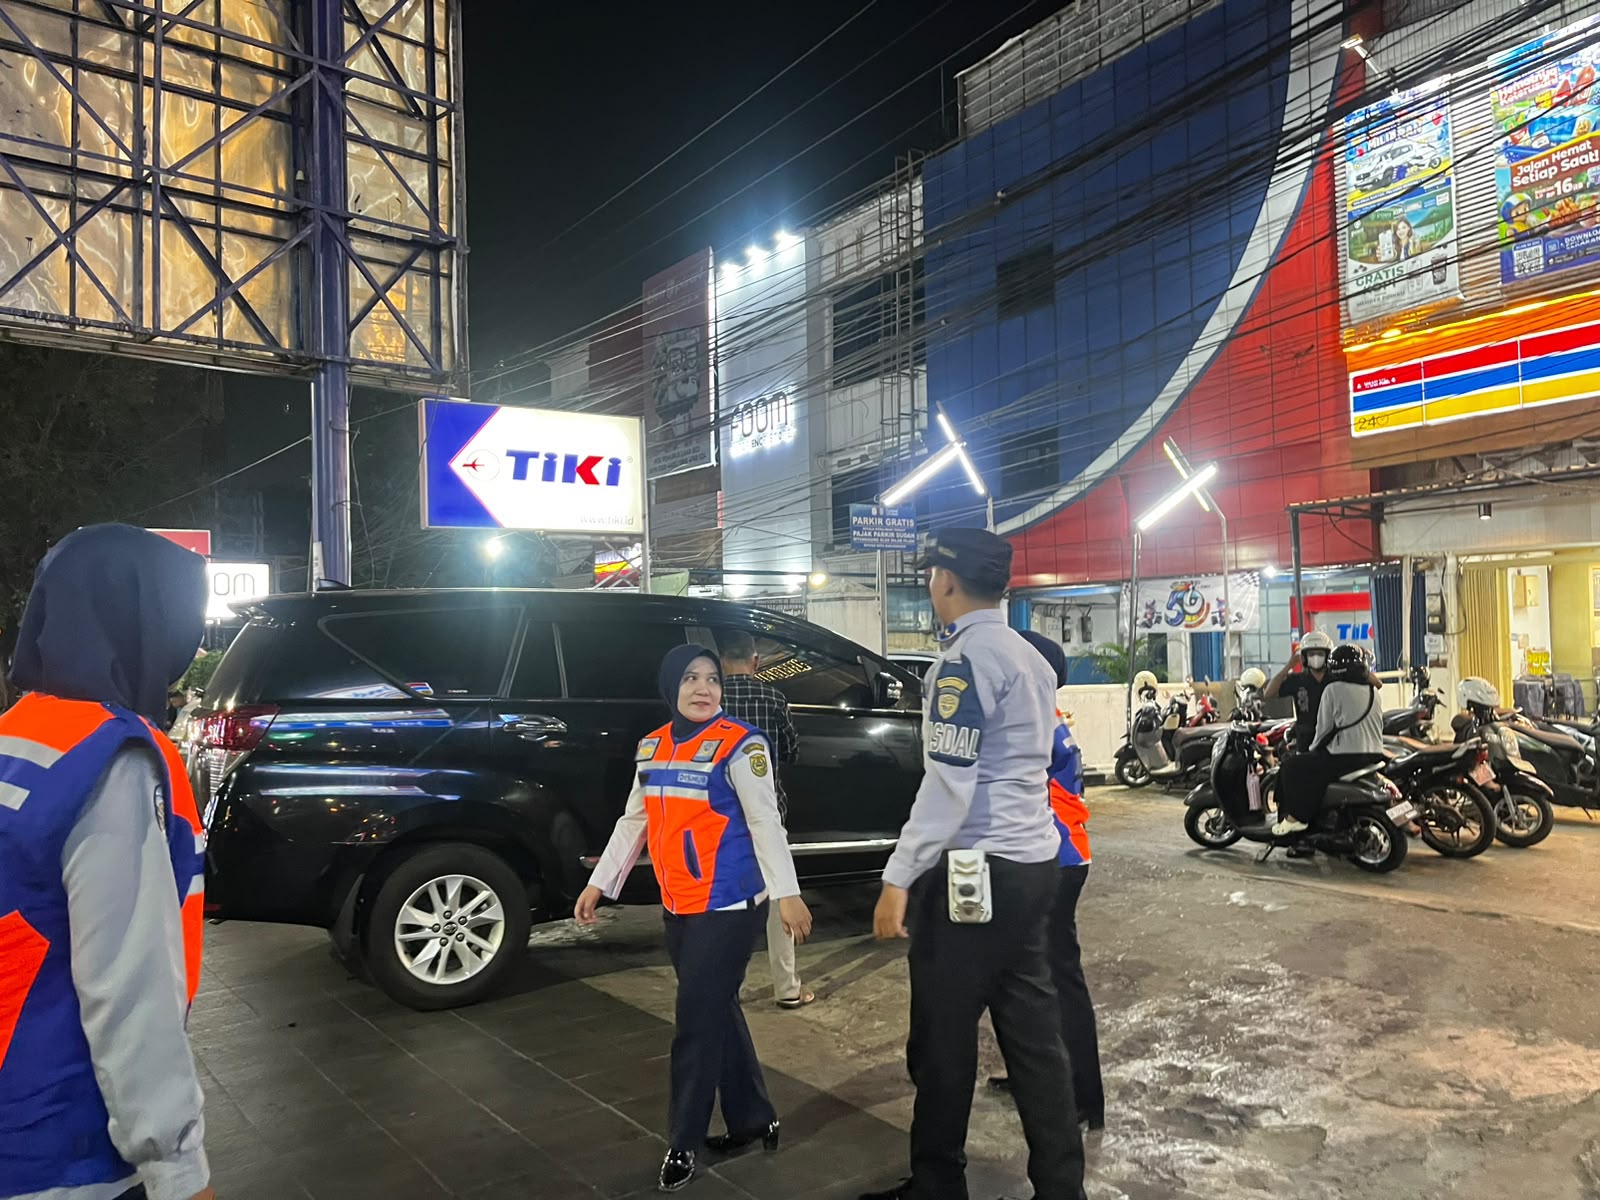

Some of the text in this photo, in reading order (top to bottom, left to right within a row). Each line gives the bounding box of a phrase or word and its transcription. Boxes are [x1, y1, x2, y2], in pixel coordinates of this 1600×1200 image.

[1517, 141, 1593, 176] Jalan Hemat
[1512, 165, 1558, 188] Setiap
[1356, 266, 1404, 287] GRATIS
[852, 516, 915, 527] PARKIR GRATIS
